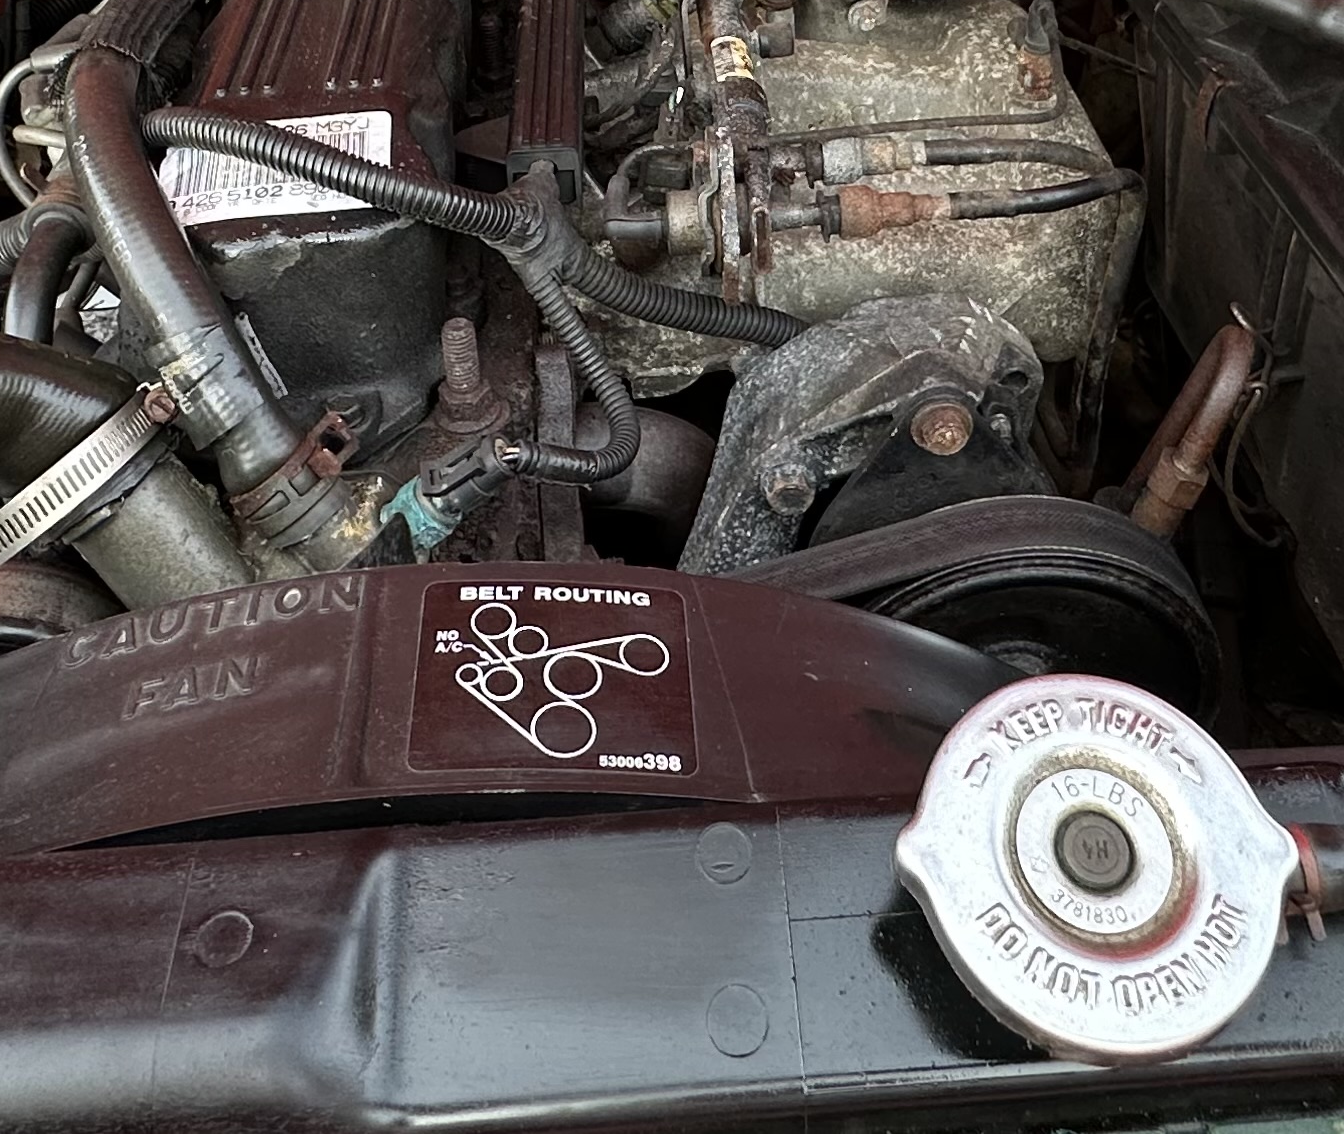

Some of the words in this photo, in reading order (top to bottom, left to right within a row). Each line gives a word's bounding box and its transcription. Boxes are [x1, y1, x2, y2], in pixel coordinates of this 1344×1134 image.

[459, 585, 525, 603] BELT
[534, 586, 651, 607] ROUTING
[62, 576, 364, 669] CAUTION
[434, 640, 464, 654] A/C
[436, 630, 460, 641] NO
[120, 656, 260, 721] FAN
[989, 699, 1063, 753] KEEP
[1075, 697, 1174, 753] TIGHT
[1050, 775, 1145, 818] 16-LBS
[976, 902, 1030, 961] DO
[1025, 945, 1103, 1008] NOT
[1111, 953, 1208, 1015] OPEN
[1200, 893, 1248, 976] HOT
